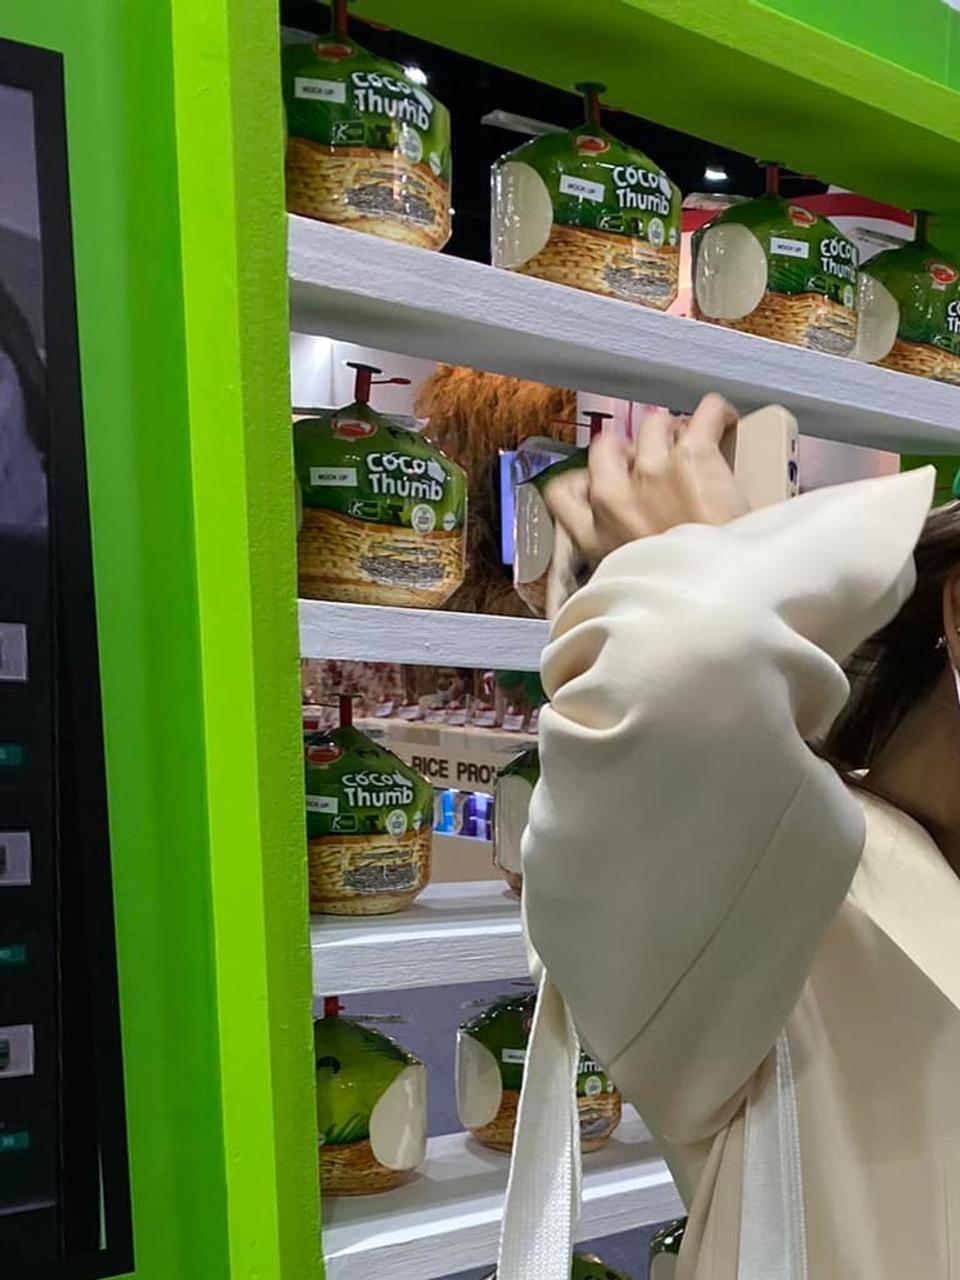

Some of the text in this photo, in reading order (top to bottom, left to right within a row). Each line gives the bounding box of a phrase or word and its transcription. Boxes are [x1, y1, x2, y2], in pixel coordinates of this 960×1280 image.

[353, 88, 430, 131] Thumb
[616, 187, 670, 215] Thumb
[368, 472, 443, 501] Thumb
[343, 786, 413, 808] Thumb
